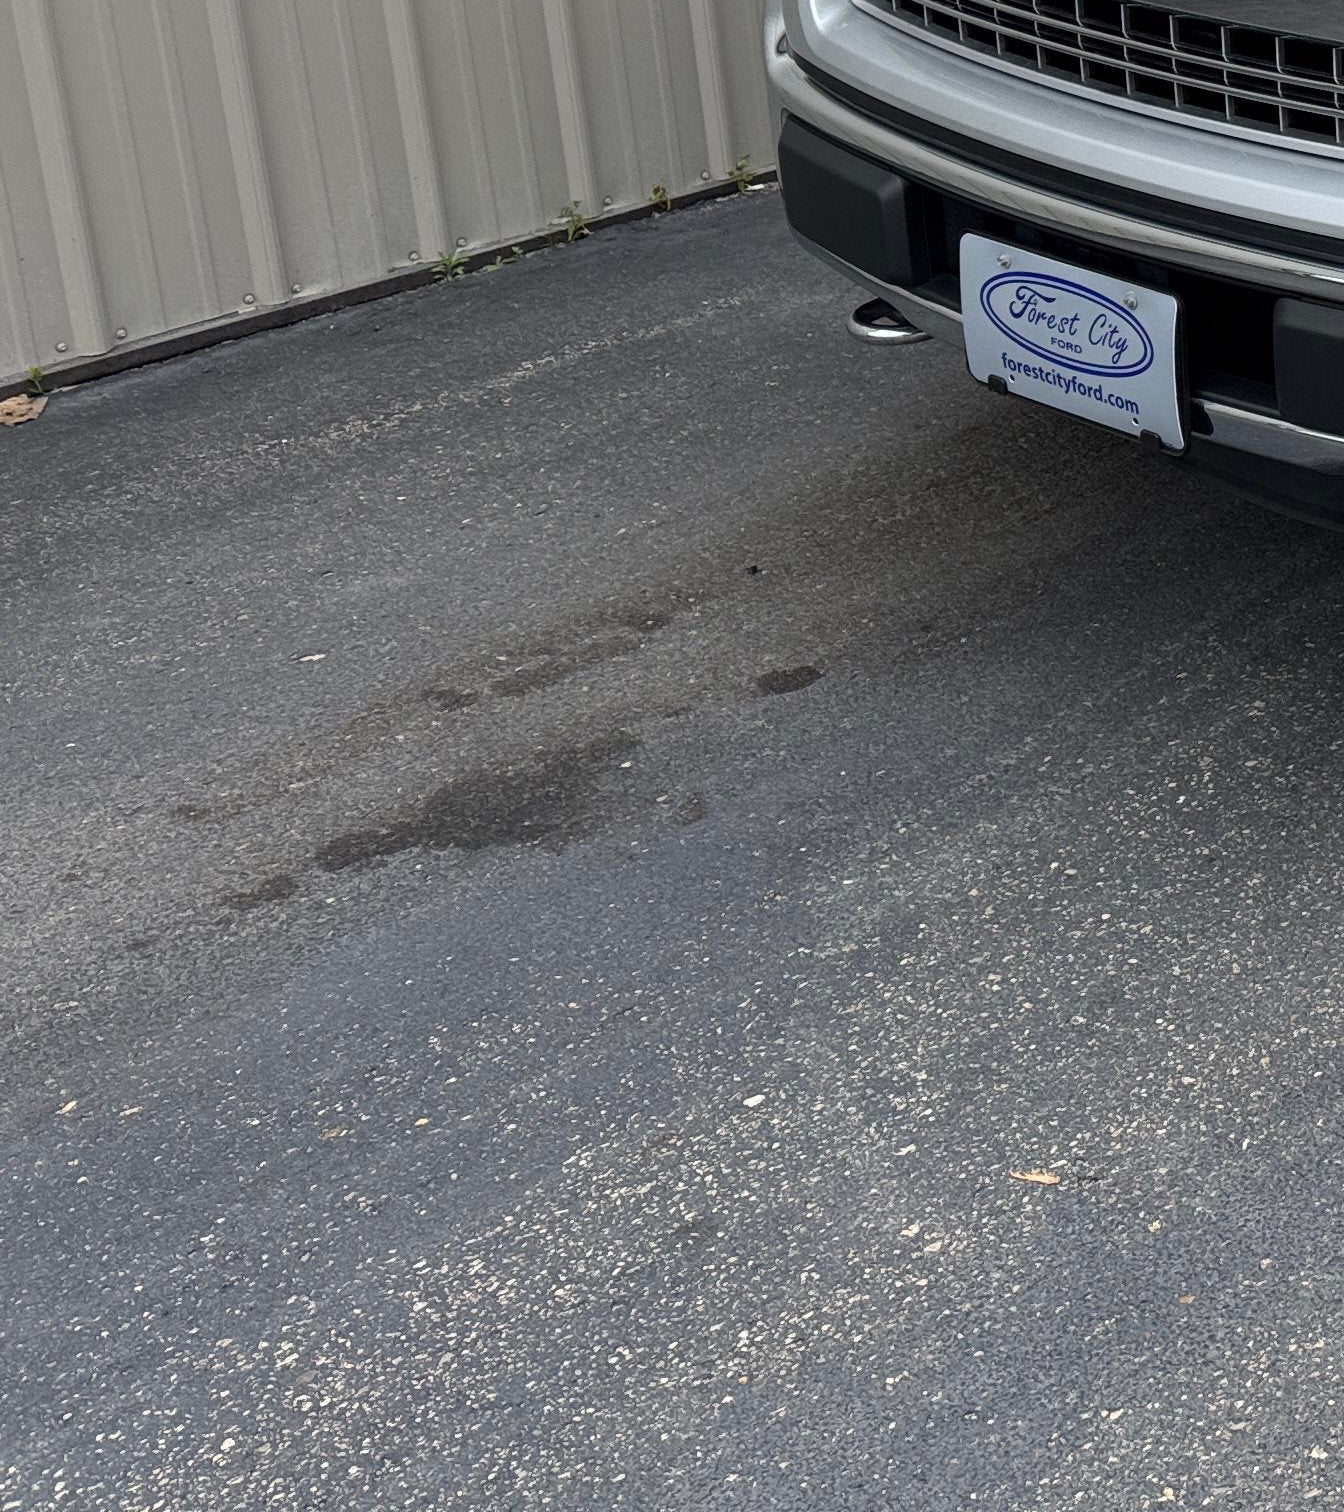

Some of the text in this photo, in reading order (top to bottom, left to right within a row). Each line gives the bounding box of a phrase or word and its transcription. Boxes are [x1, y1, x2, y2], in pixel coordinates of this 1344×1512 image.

[1009, 285, 1128, 365] Forest City
[1050, 336, 1083, 355] FORD
[1001, 352, 1140, 416] forestcityford.com
